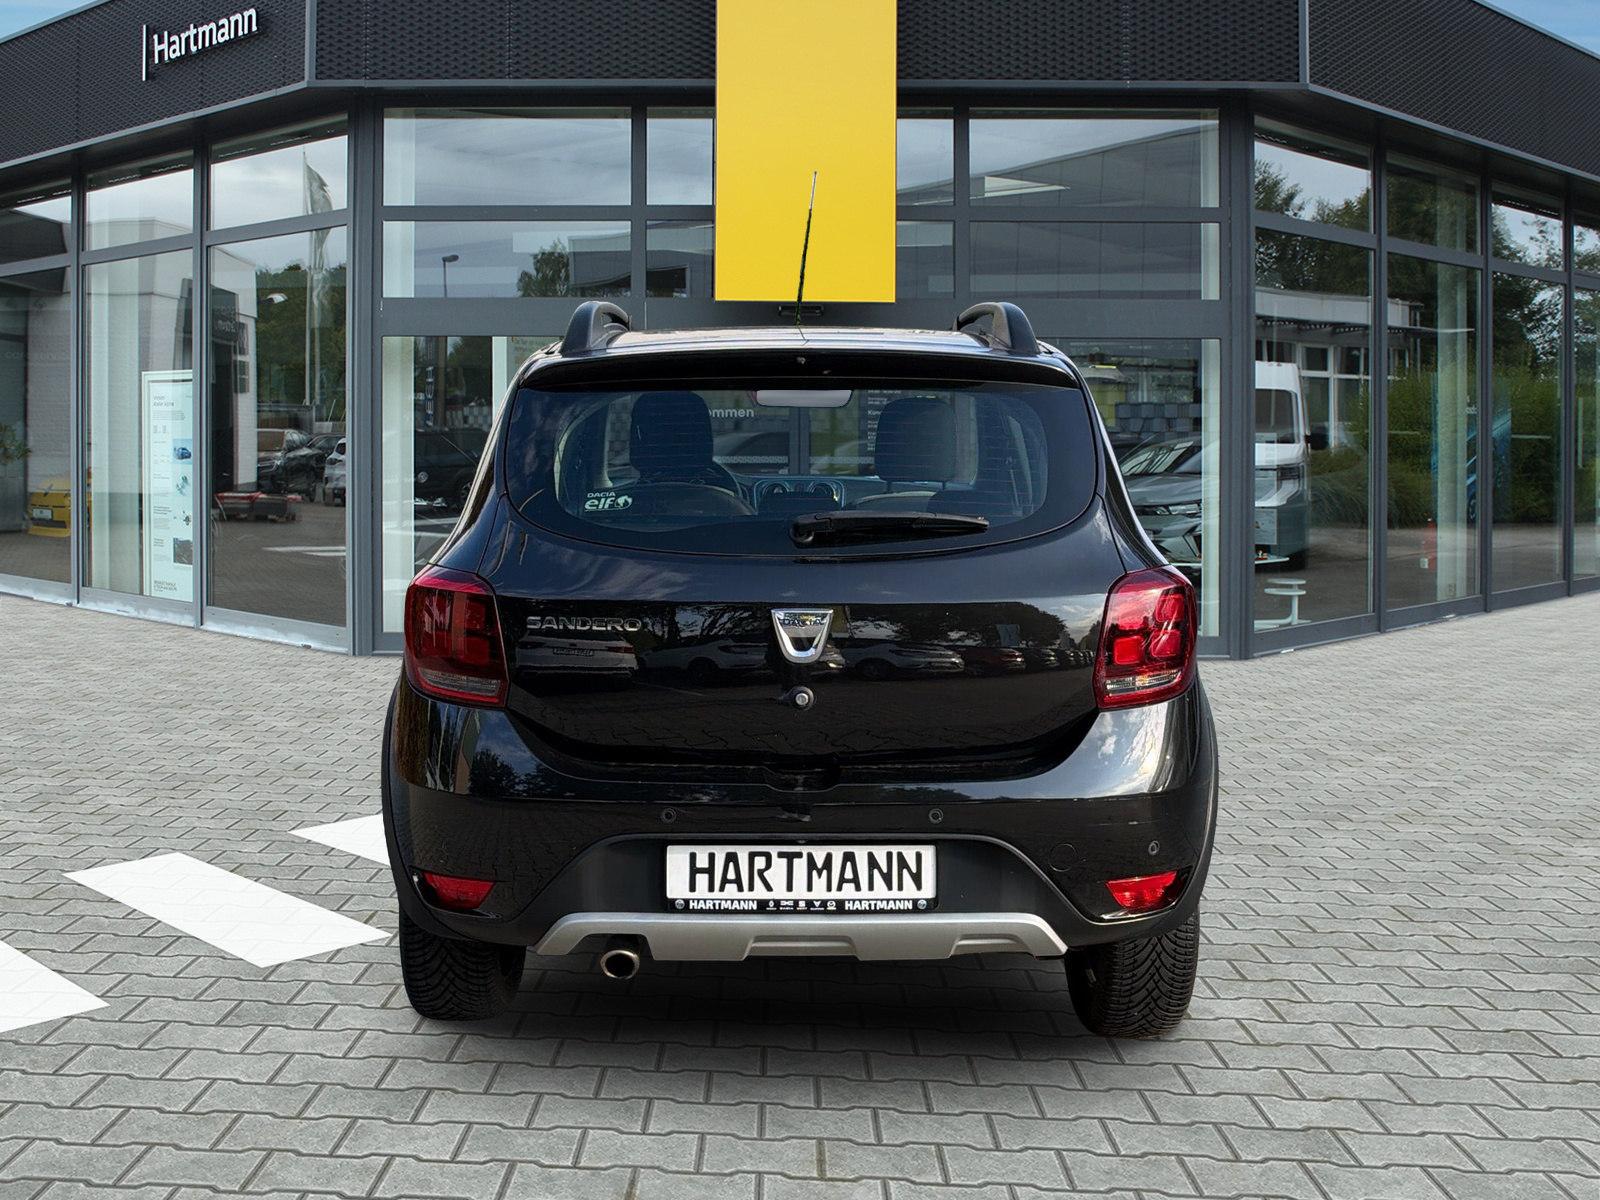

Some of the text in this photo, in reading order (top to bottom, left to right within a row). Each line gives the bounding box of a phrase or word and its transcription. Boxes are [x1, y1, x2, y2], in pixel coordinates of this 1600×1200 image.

[152, 8, 258, 65] Hartmann
[584, 497, 616, 511] elf
[526, 615, 642, 631] SANDERO
[688, 850, 923, 893] HARTMANN
[688, 899, 913, 911] HARTMANN HARTMANN
